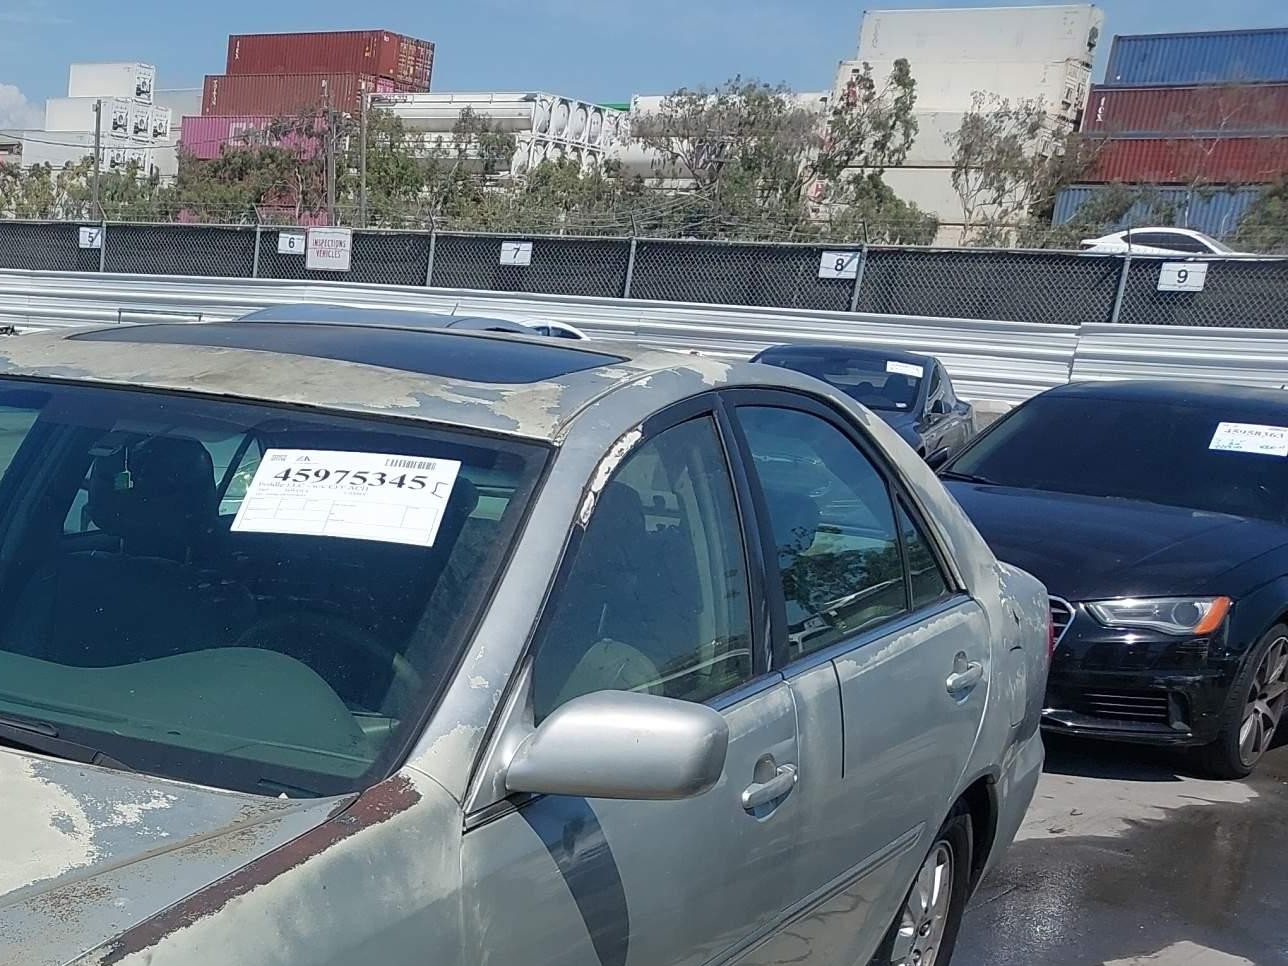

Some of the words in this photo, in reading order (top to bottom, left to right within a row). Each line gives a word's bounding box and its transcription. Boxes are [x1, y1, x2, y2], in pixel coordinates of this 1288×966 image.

[87, 231, 94, 243] 5
[288, 237, 295, 249] 6
[312, 238, 347, 249] INSPECTIONS
[316, 249, 341, 259] VEHICLES
[513, 247, 520, 259] 7
[834, 257, 845, 272] 8
[1177, 269, 1189, 284] 9
[273, 467, 429, 490] 45975345
